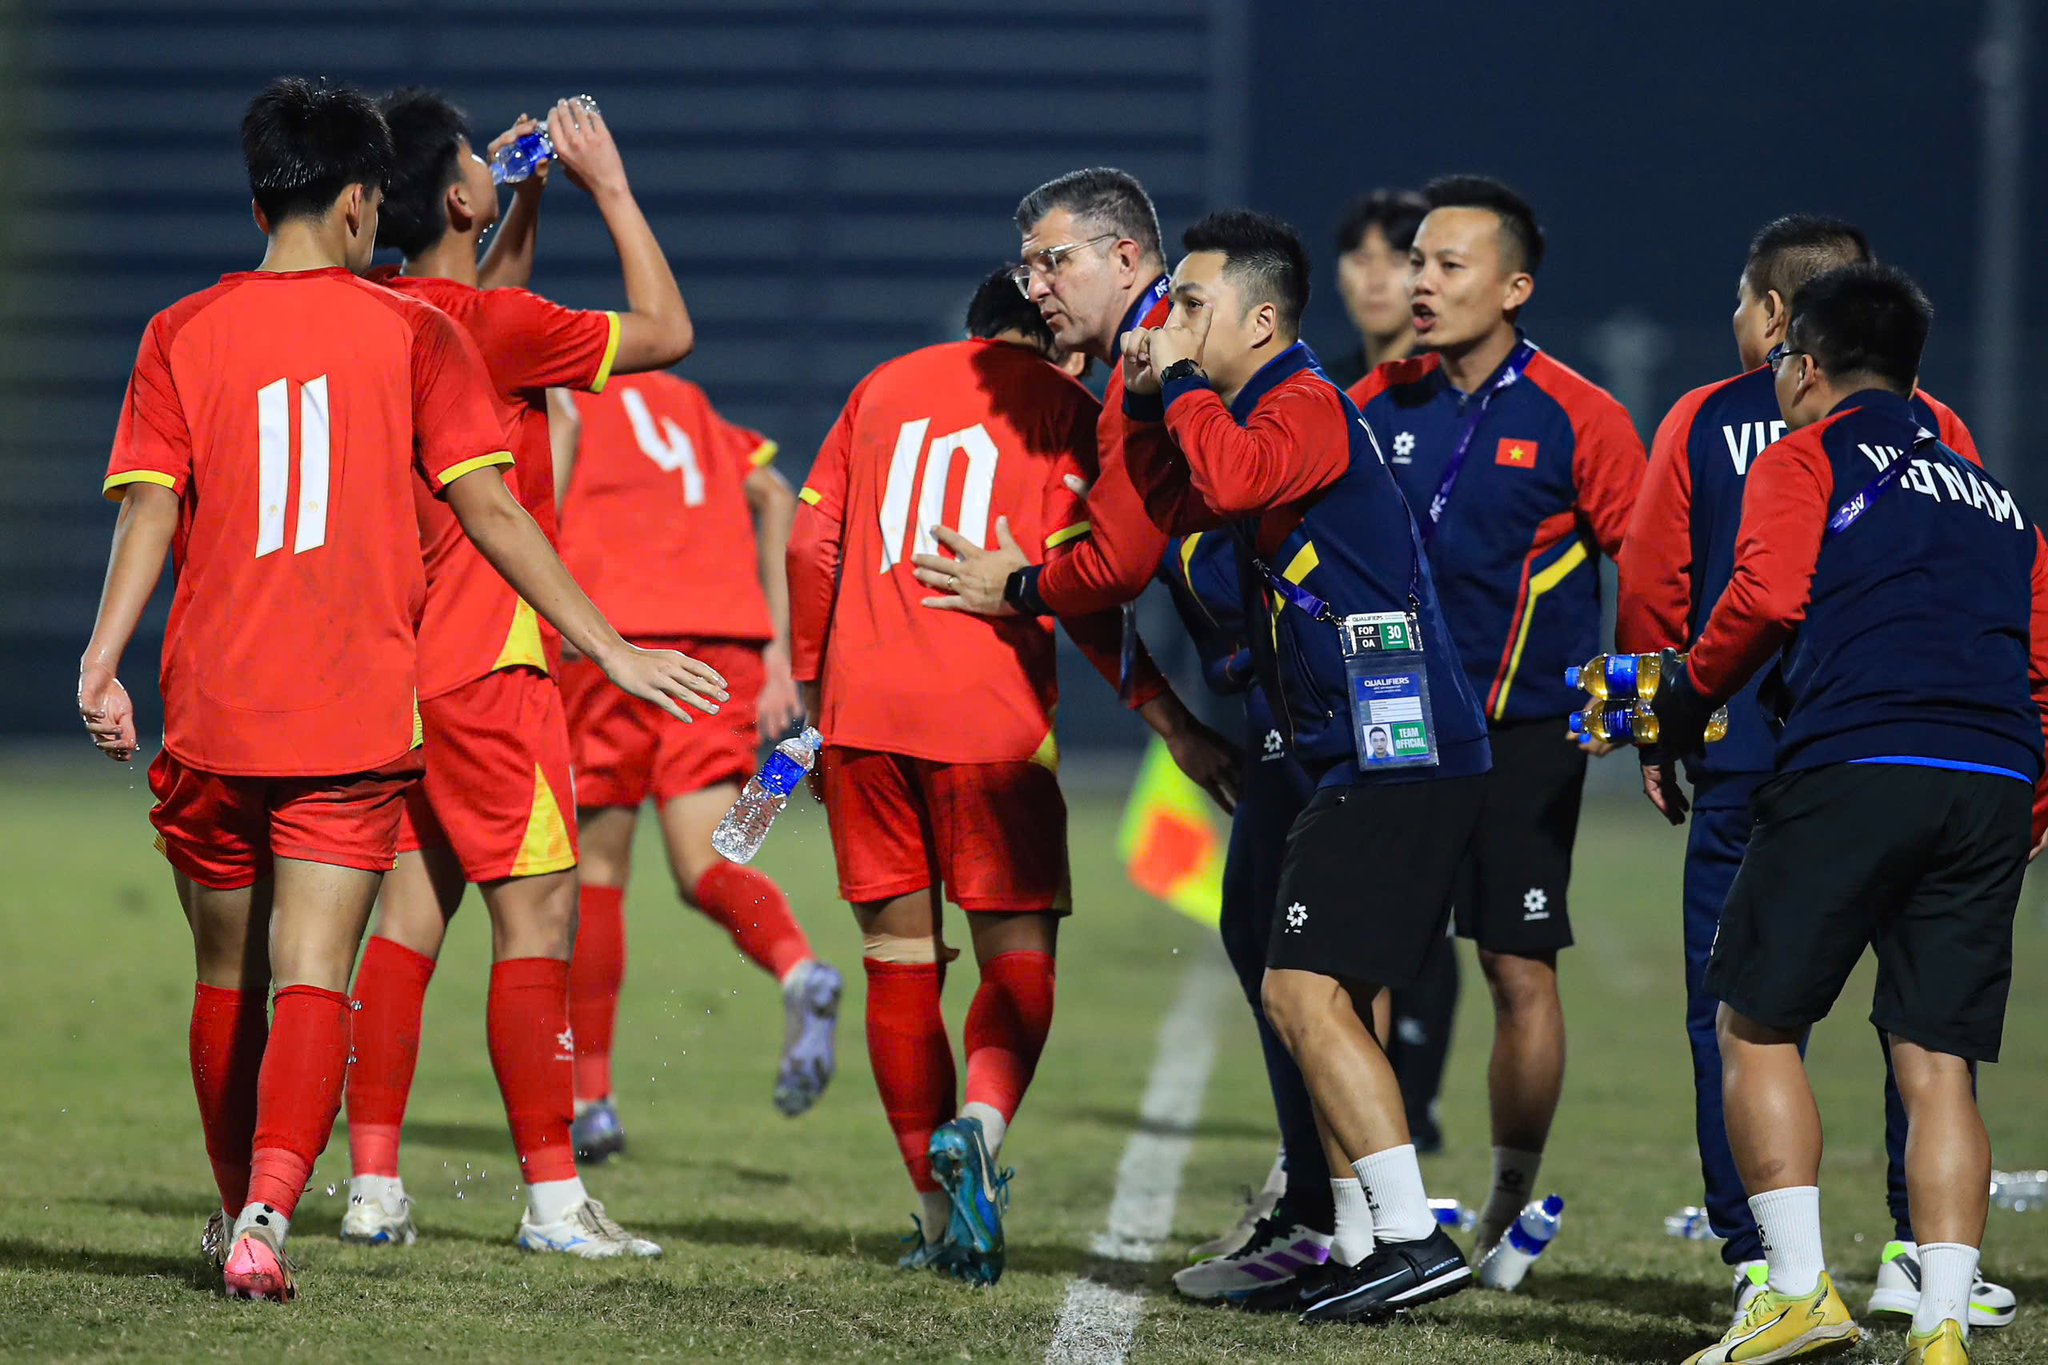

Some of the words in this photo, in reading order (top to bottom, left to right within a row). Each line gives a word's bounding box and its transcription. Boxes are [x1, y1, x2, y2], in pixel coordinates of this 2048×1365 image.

[621, 387, 705, 507] 4
[255, 373, 331, 559] 11
[879, 417, 999, 575] 10
[1842, 492, 1865, 521] AFC
[1357, 626, 1375, 636] FOP
[1386, 624, 1402, 640] 30
[1361, 639, 1376, 648] OA
[1364, 676, 1410, 688] QUALIFIERS
[1398, 727, 1420, 738] TEAM
[1395, 737, 1426, 749] OFFICIAL
